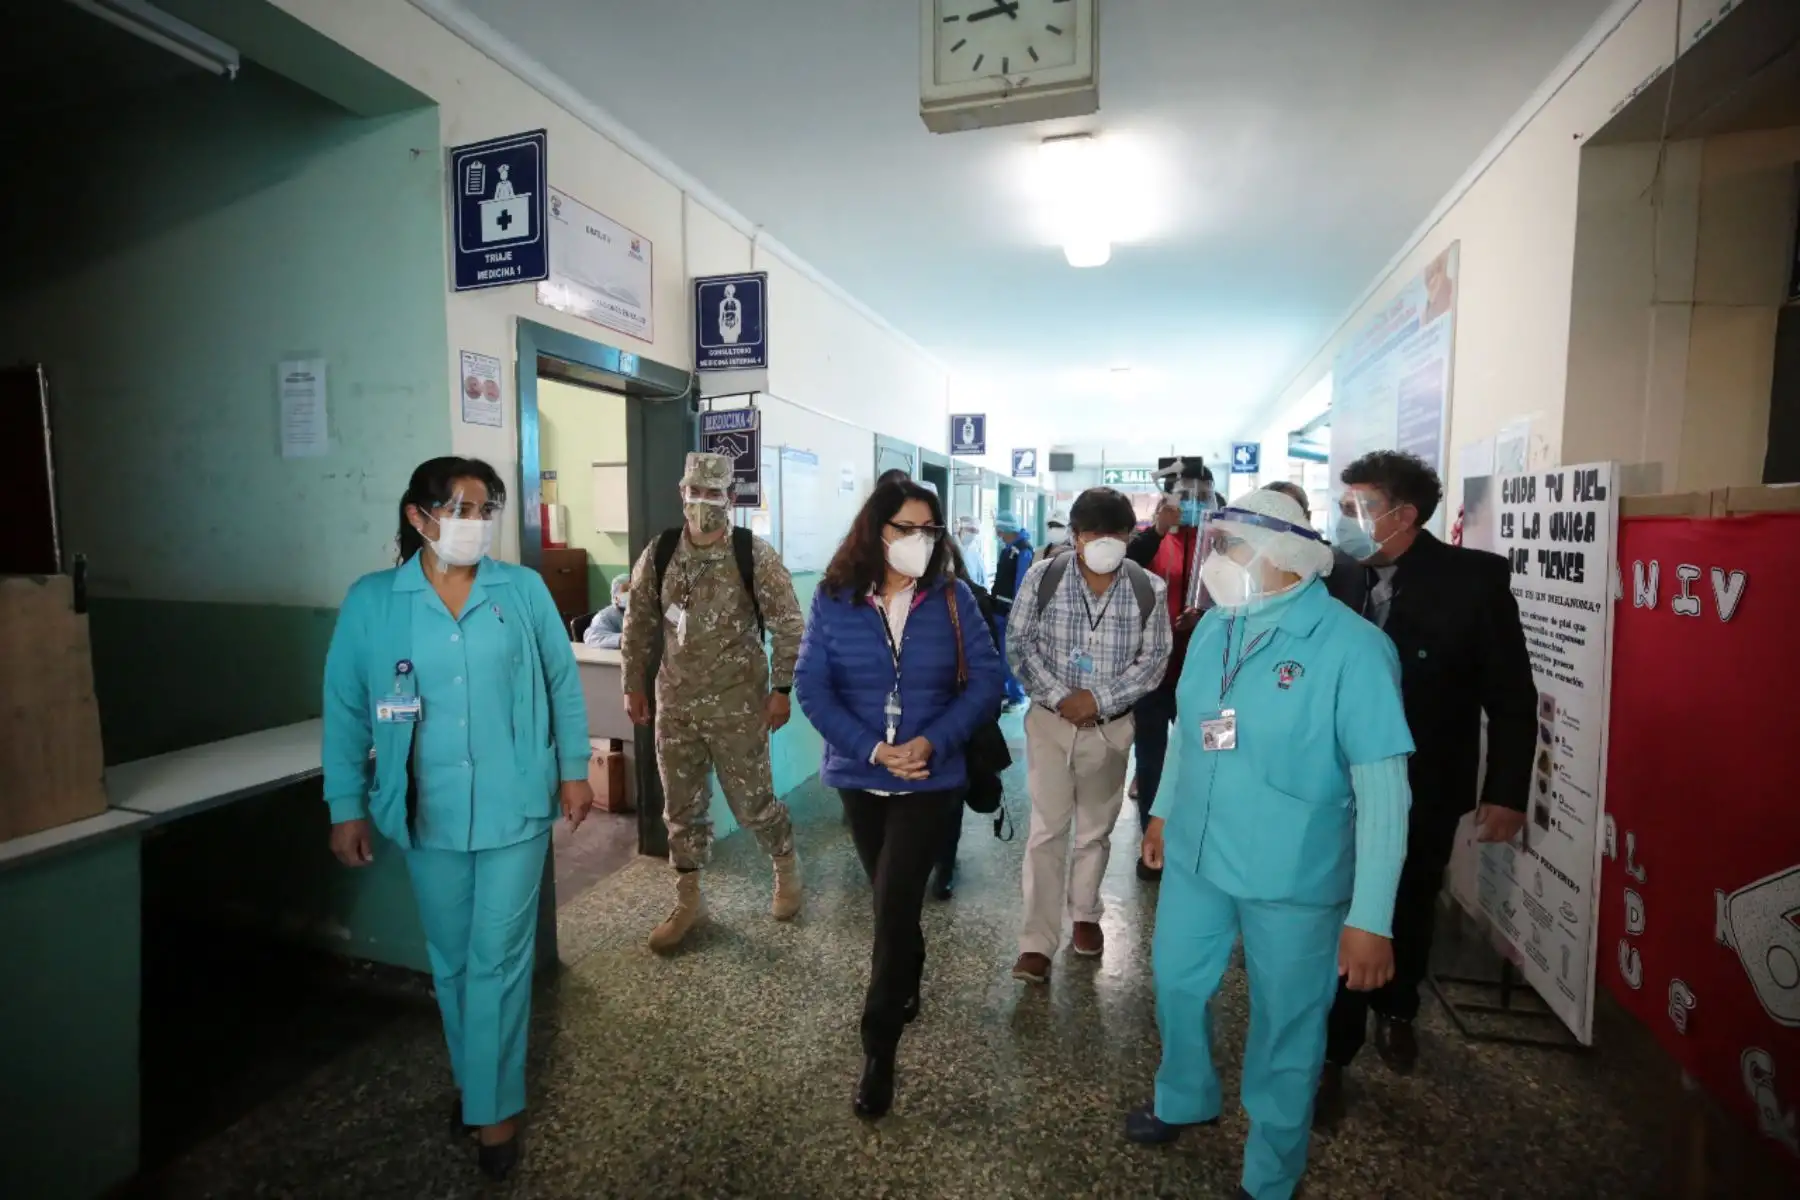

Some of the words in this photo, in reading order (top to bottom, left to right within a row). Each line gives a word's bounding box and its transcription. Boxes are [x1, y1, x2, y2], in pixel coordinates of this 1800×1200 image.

[484, 251, 513, 263] TRIAJE
[477, 267, 515, 280] MEDICINA
[517, 265, 521, 275] 1
[708, 347, 752, 357] CONSULTORIO
[699, 358, 728, 367] MEDICINA
[729, 357, 756, 366] INTERNA
[704, 412, 746, 431] MEDICINA
[1121, 470, 1154, 482] SALI
[1502, 476, 1536, 504] CUIDA
[1545, 473, 1564, 502] TU
[1573, 468, 1606, 502] PIEL
[1501, 512, 1514, 538] ES
[1522, 511, 1541, 540] LA
[1549, 511, 1595, 543] UNICA
[1538, 549, 1584, 583] TIENES
[1525, 590, 1533, 600] ES
[1536, 592, 1546, 601] UN
[1548, 594, 1601, 613] MELANOMA?
[1559, 618, 1572, 630] piel
[1573, 624, 1586, 634] que
